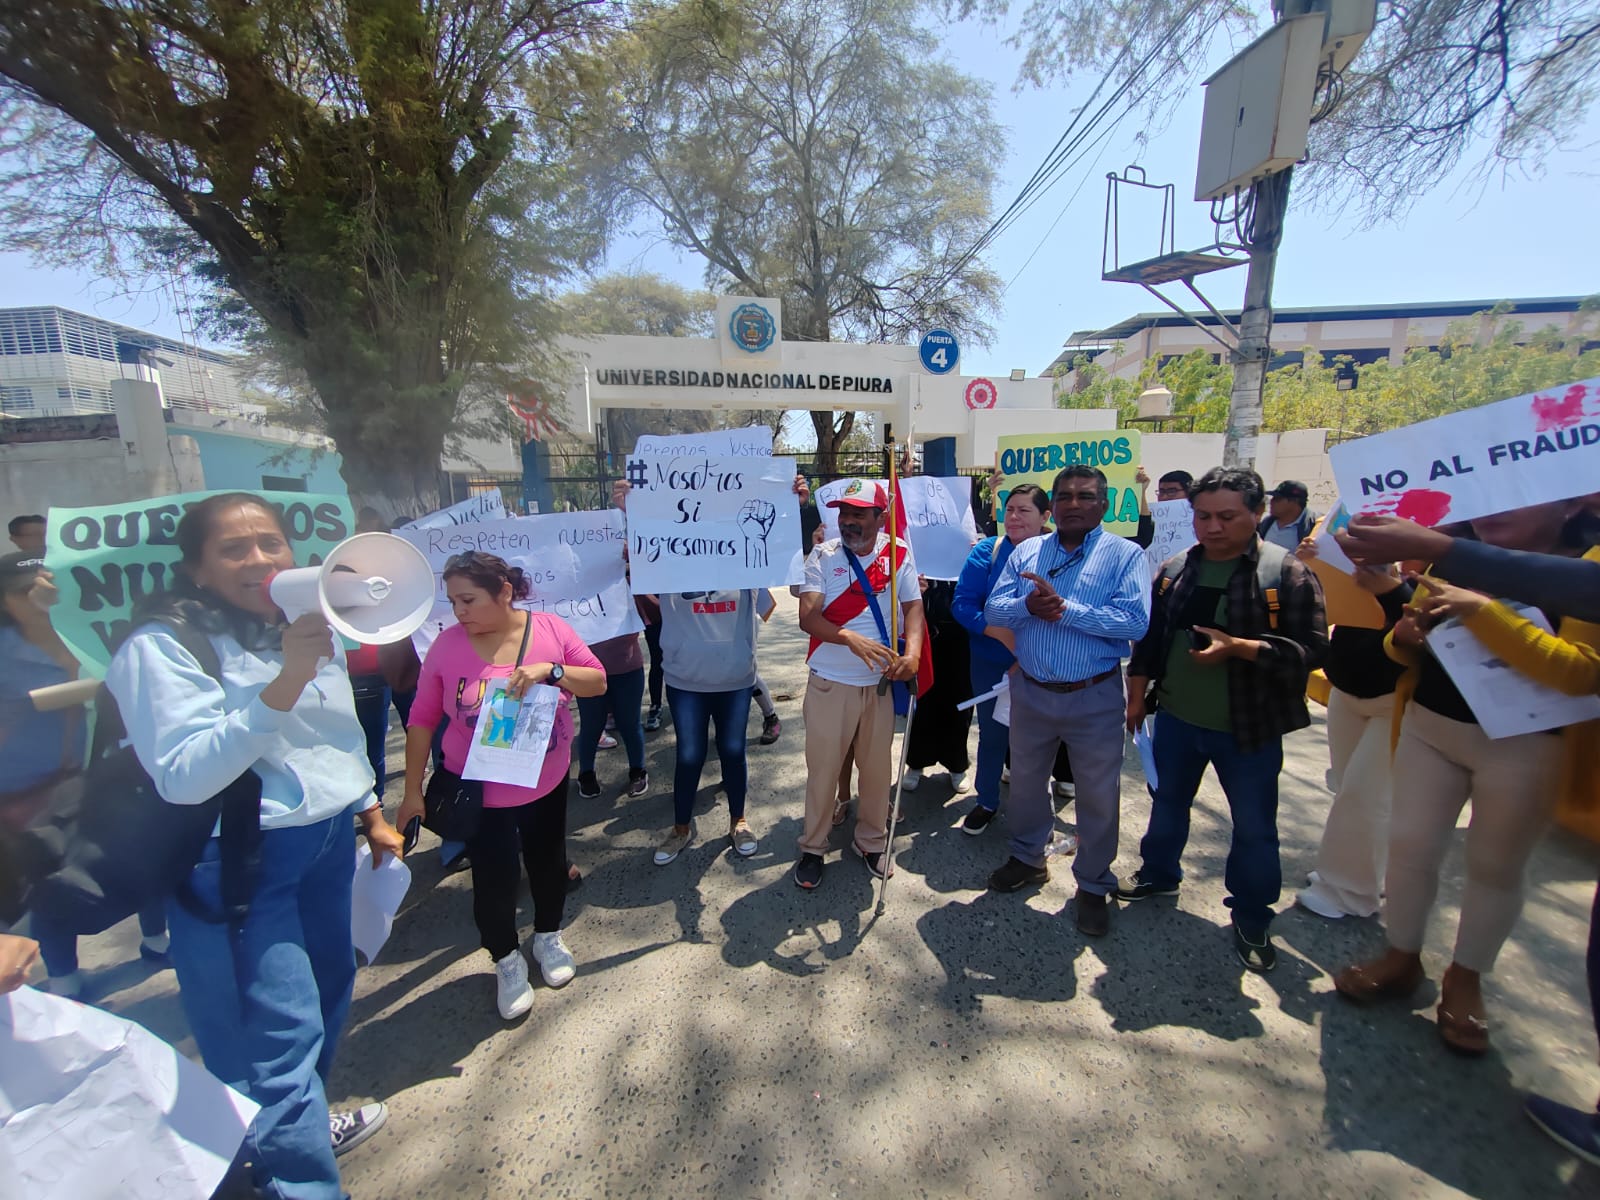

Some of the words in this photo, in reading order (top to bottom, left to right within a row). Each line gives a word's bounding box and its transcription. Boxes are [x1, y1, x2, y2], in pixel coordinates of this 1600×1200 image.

[927, 335, 953, 345] PUERTA
[930, 347, 948, 368] 4
[596, 368, 725, 388] UNIVERSIDAD
[726, 372, 816, 390] NACIONAL
[818, 375, 841, 390] DE
[842, 376, 893, 393] PIURA
[1001, 437, 1133, 475] QUEREMOS
[1360, 469, 1409, 496] NO
[1429, 455, 1474, 481] AL
[427, 526, 531, 555] Respeten
[633, 530, 737, 562] Ingresamos
[698, 602, 732, 613] AIR
